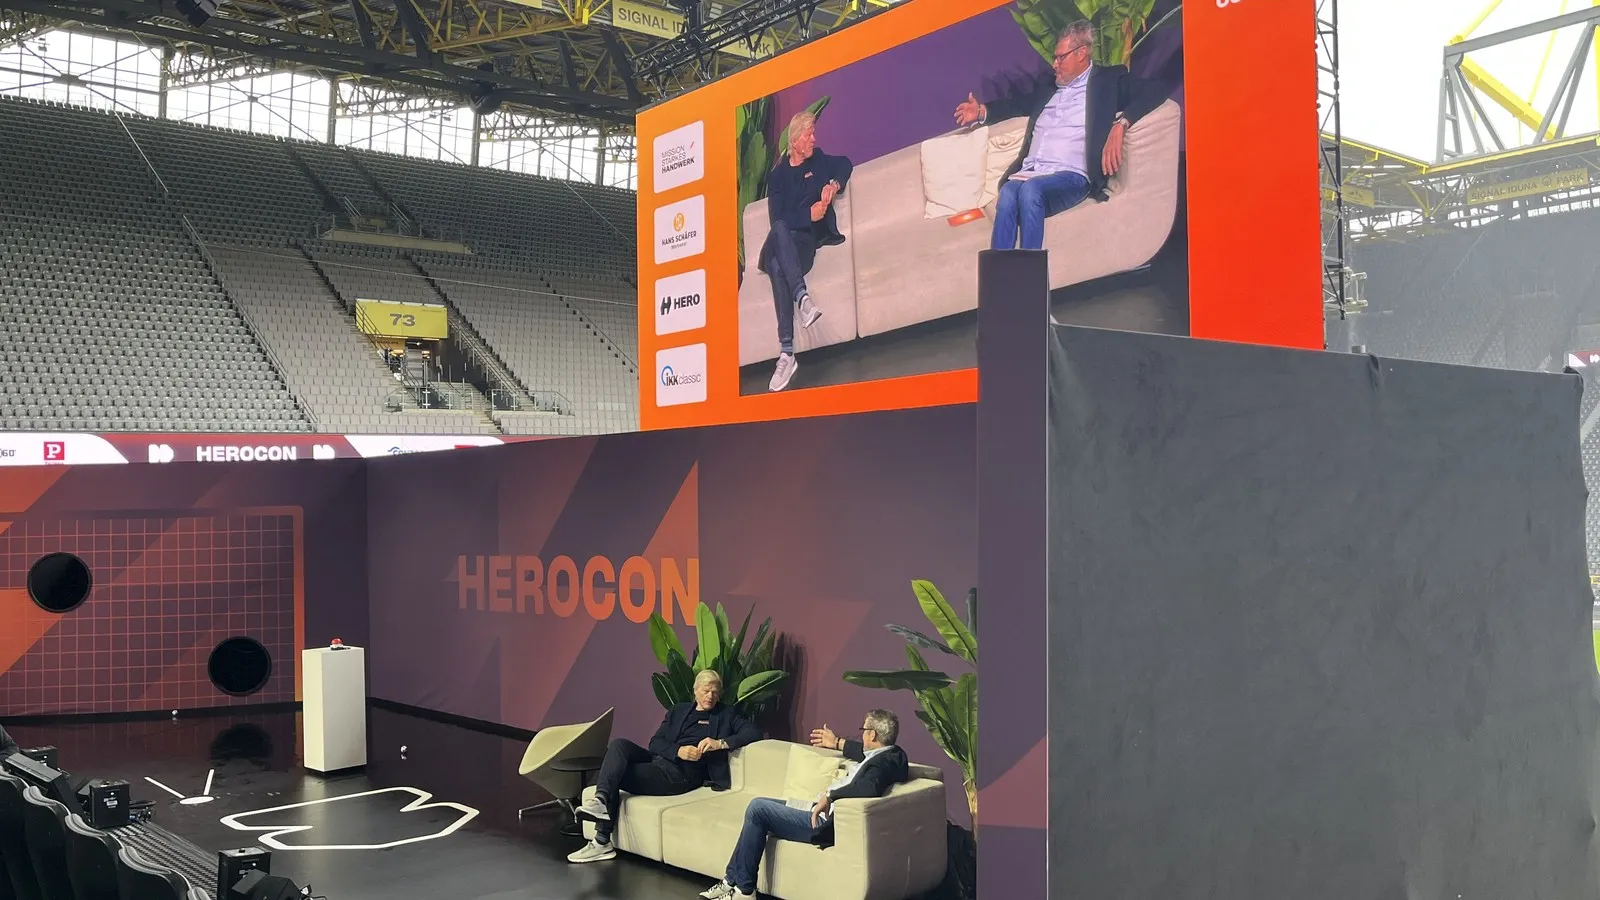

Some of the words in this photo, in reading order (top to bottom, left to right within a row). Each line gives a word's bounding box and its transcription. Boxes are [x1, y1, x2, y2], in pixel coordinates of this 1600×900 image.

[618, 7, 669, 31] SIGNAL
[661, 145, 685, 158] MISSION
[661, 156, 695, 173] HANDWERK
[1471, 187, 1505, 200] SIGNAL
[1508, 181, 1538, 194] IDUNA
[1556, 173, 1584, 185] PARK
[661, 237, 675, 246] HANS
[673, 293, 700, 309] HERO
[389, 313, 416, 327] 73
[196, 446, 298, 462] HEROCON
[458, 555, 699, 626] HEROCON
